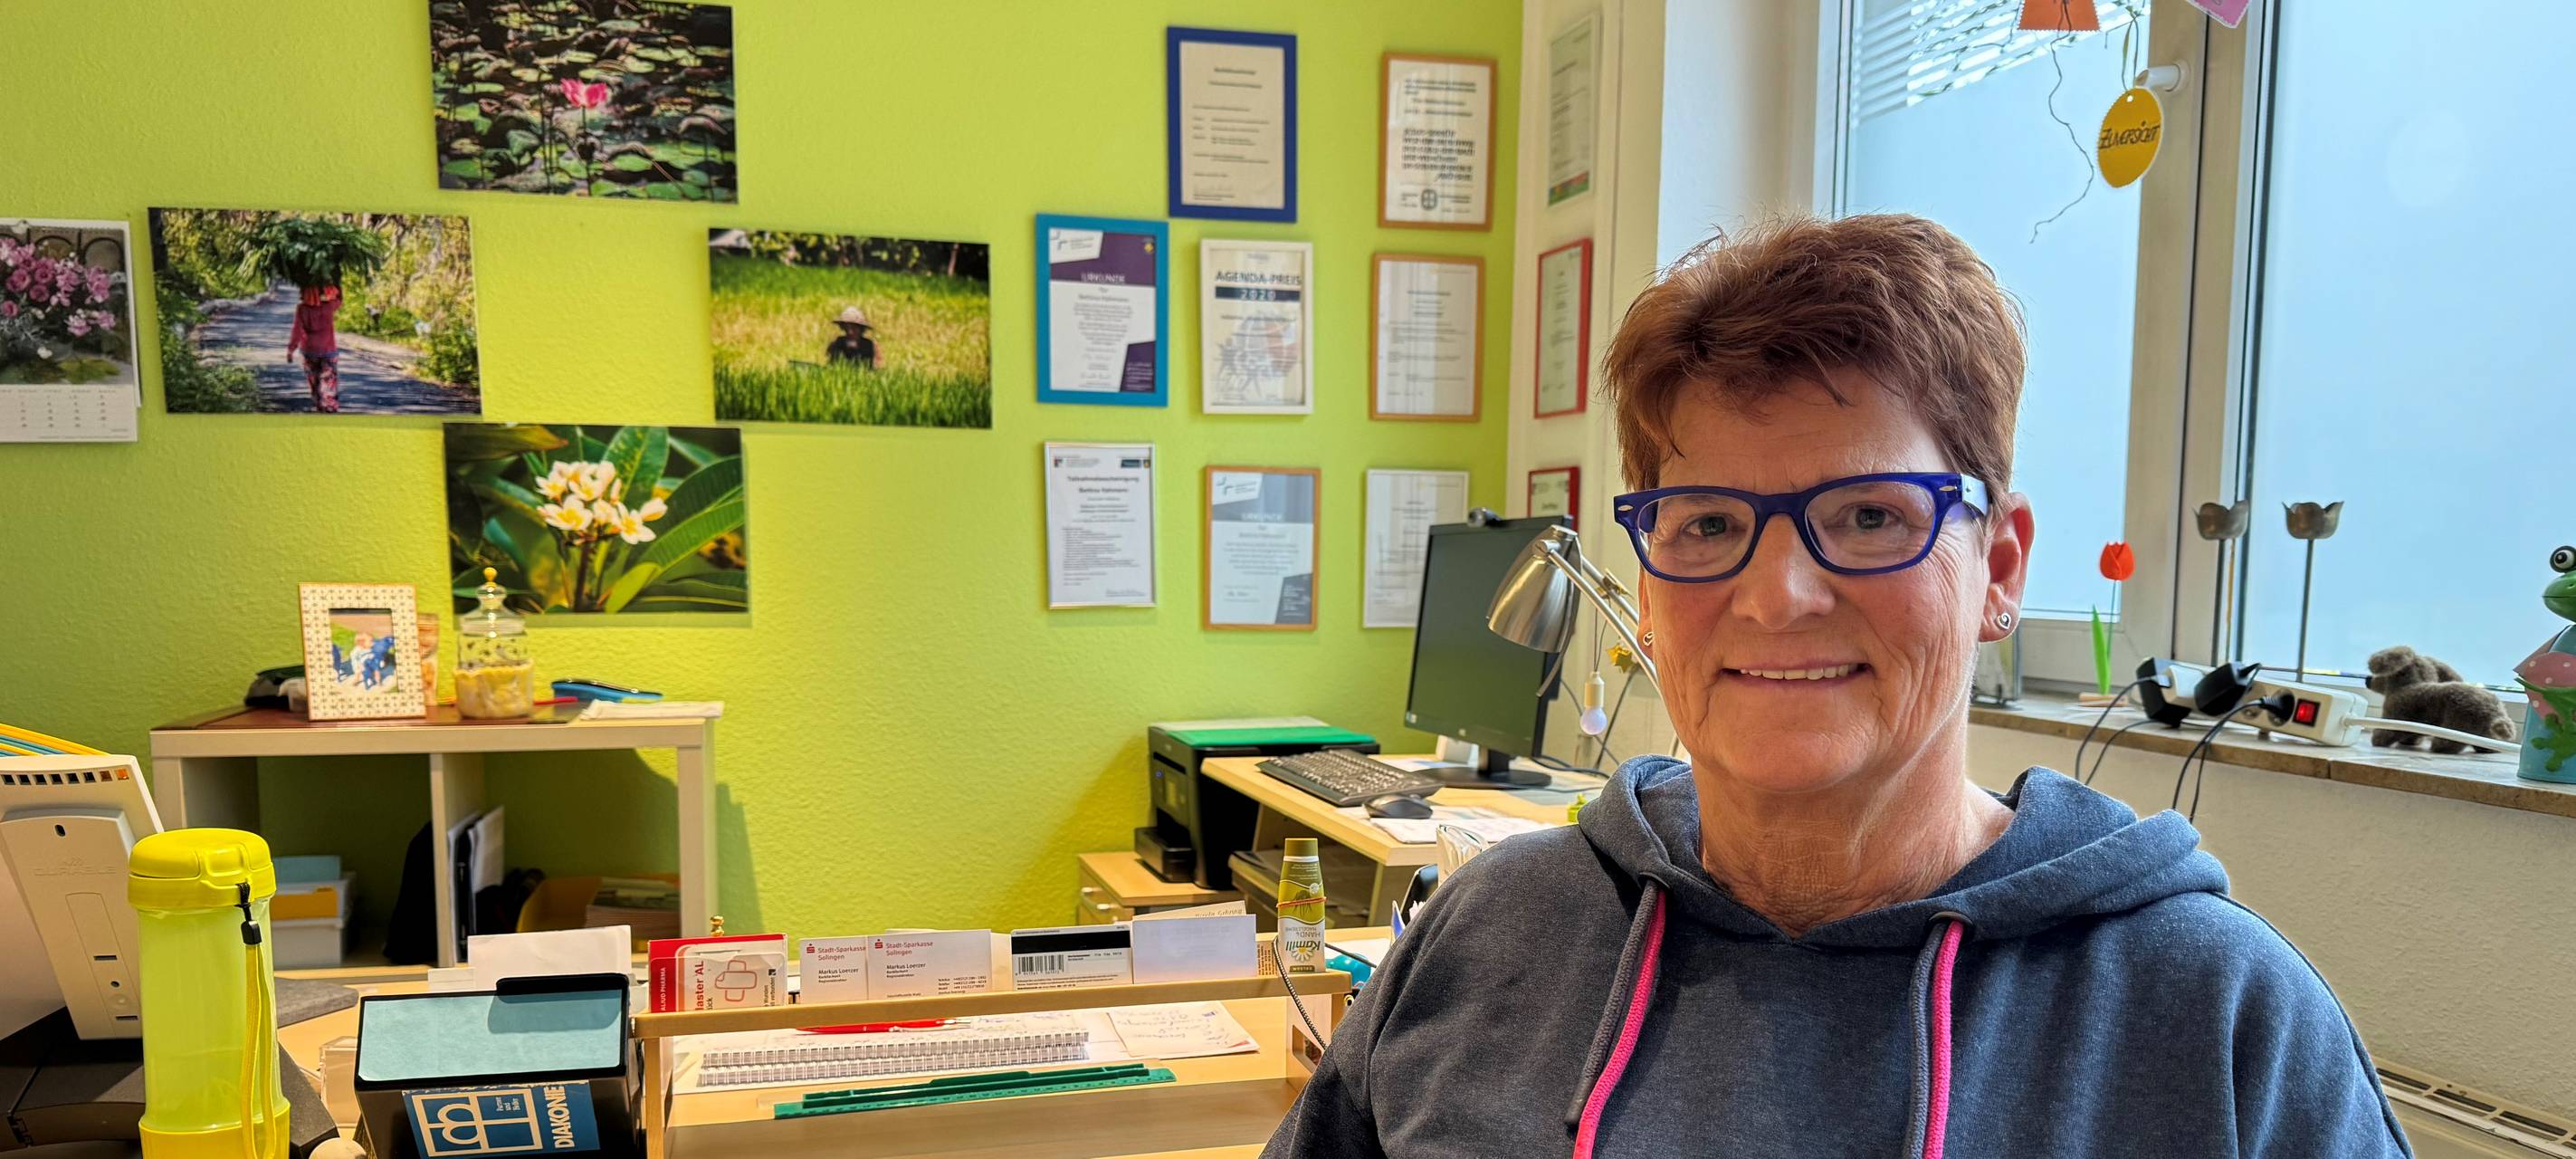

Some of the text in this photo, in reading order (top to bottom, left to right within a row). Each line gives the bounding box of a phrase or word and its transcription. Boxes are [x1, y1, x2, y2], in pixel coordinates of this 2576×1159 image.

[1216, 271, 1302, 285] AGENDA-PREIS
[817, 944, 866, 953] Stadt-Sparkasse
[1285, 940, 1321, 952] Kamill
[694, 979, 703, 1011] laster
[543, 1086, 575, 1148] DIAKONIE
